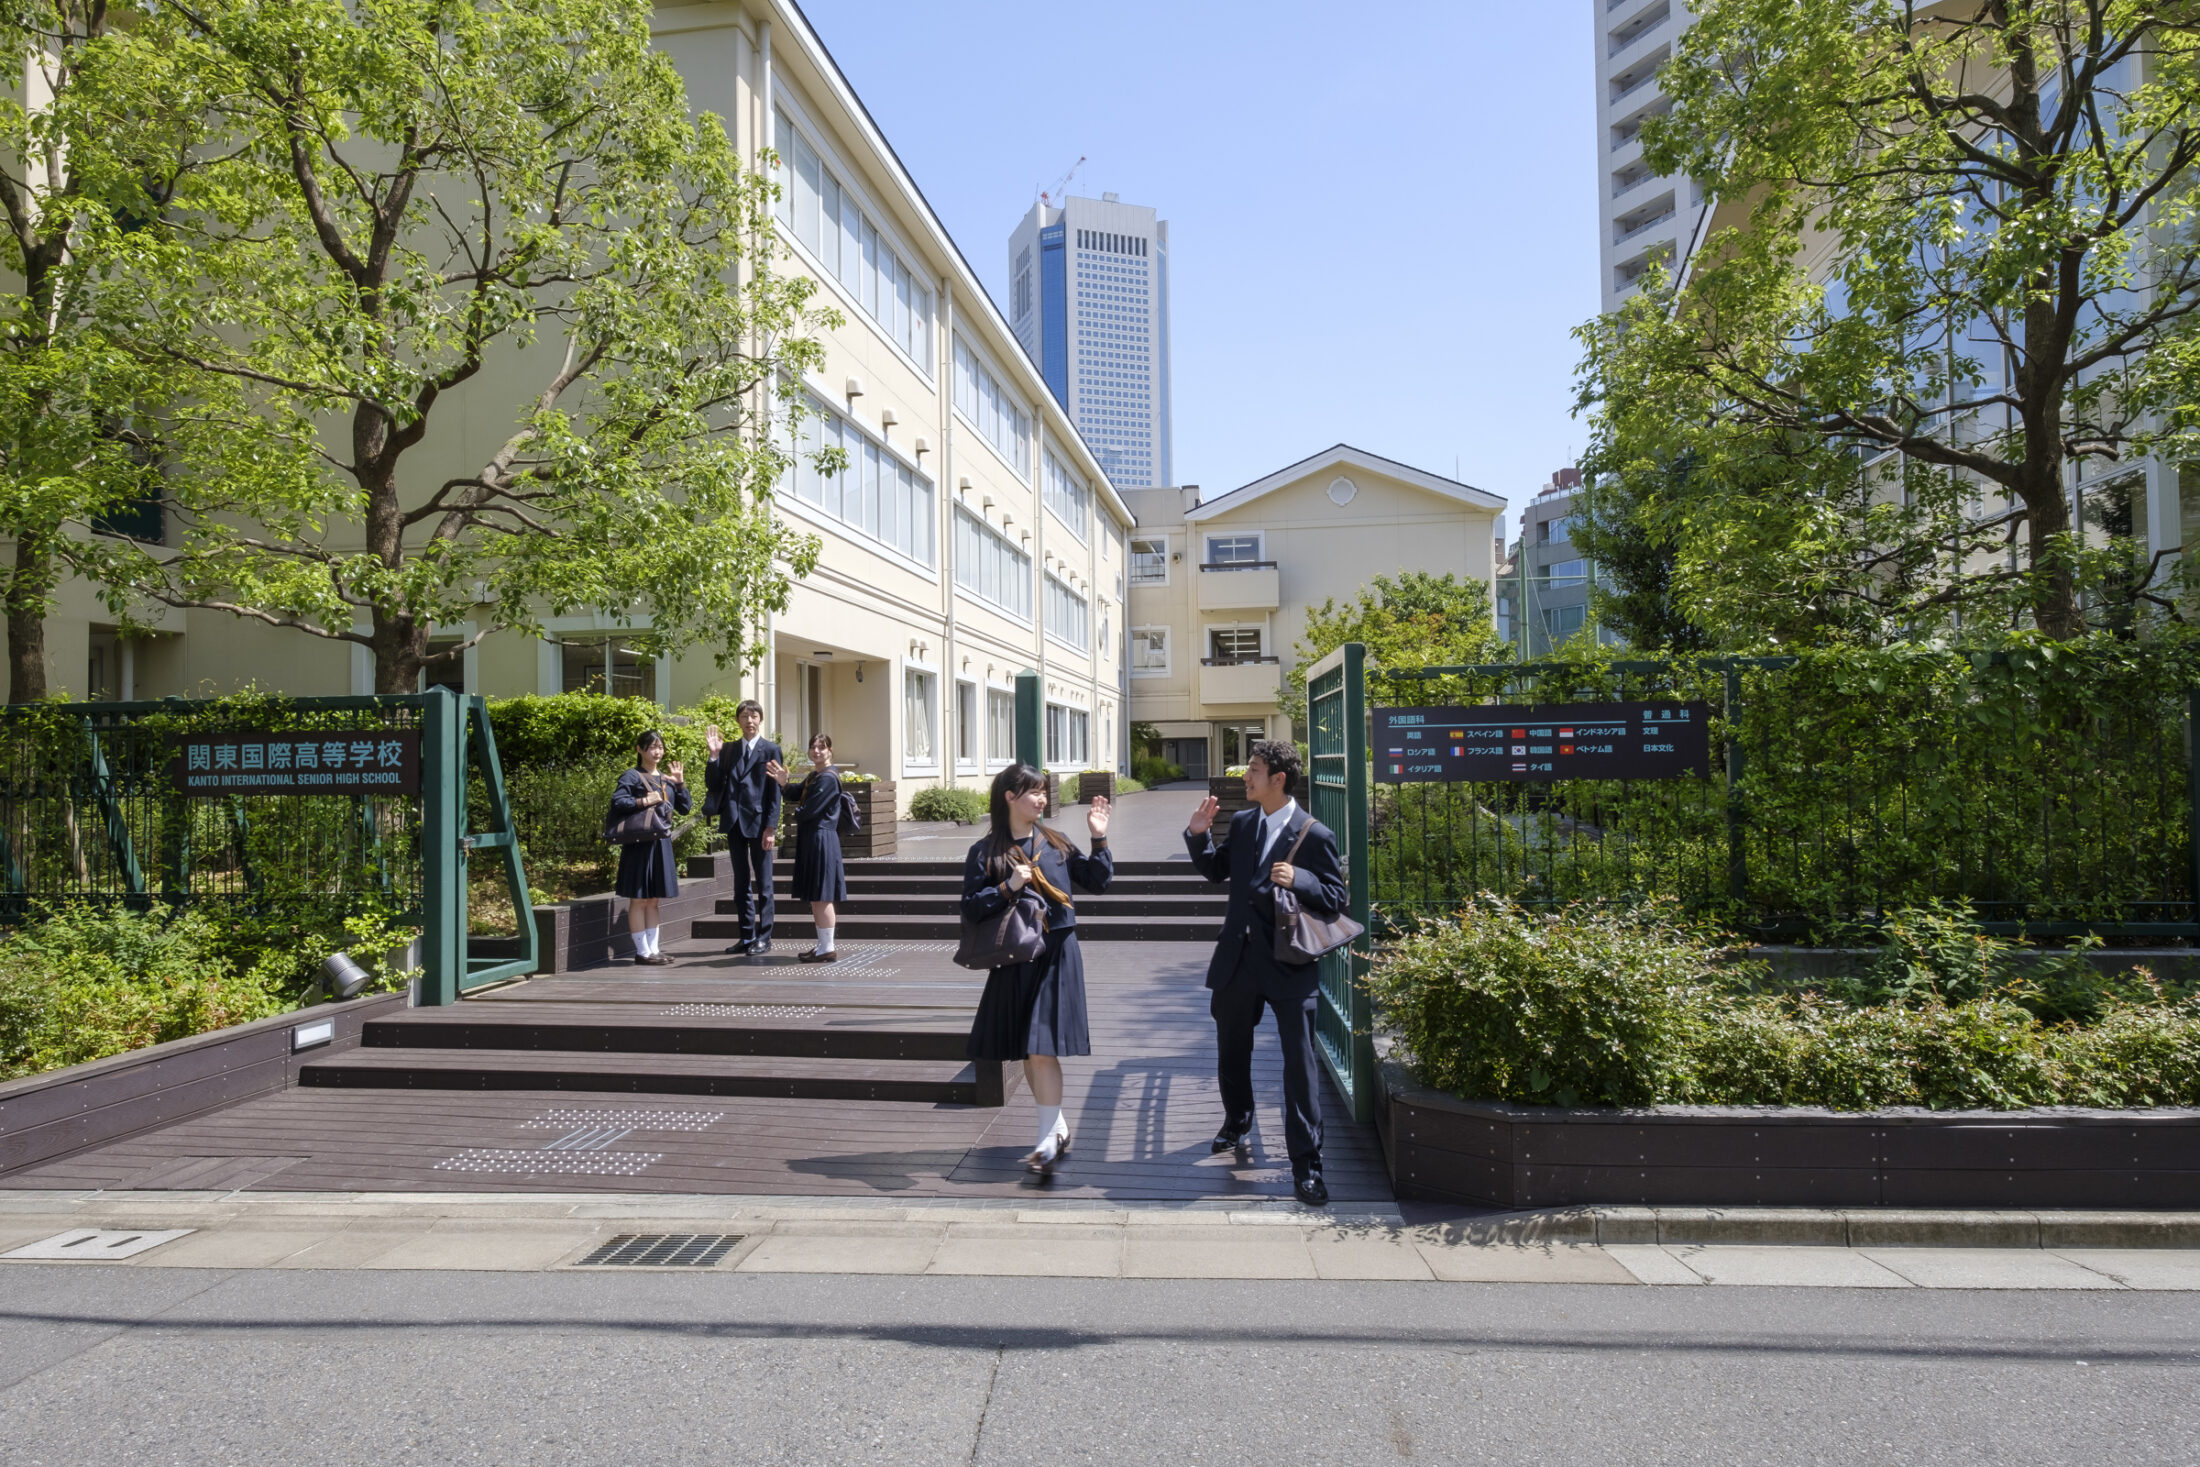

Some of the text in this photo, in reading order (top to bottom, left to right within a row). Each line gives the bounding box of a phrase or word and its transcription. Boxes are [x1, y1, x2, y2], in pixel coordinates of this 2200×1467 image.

[1389, 715, 1425, 725] 外国語科
[1467, 730, 1503, 738] スペイン語
[1529, 729, 1552, 737] 中国語
[1576, 728, 1626, 736] インドネシア語
[1407, 748, 1435, 756] ロシア語
[1467, 747, 1503, 755] フランス語
[1576, 745, 1612, 753] ベトナム語
[1643, 744, 1674, 752] 日本文化
[188, 740, 402, 771] 関東国際高等学校
[1408, 765, 1441, 773] イタリア語
[1530, 763, 1552, 771] タイ語
[188, 772, 401, 786] KANTO INTERNATIONAL SENIOR HIGH SCHOOL
